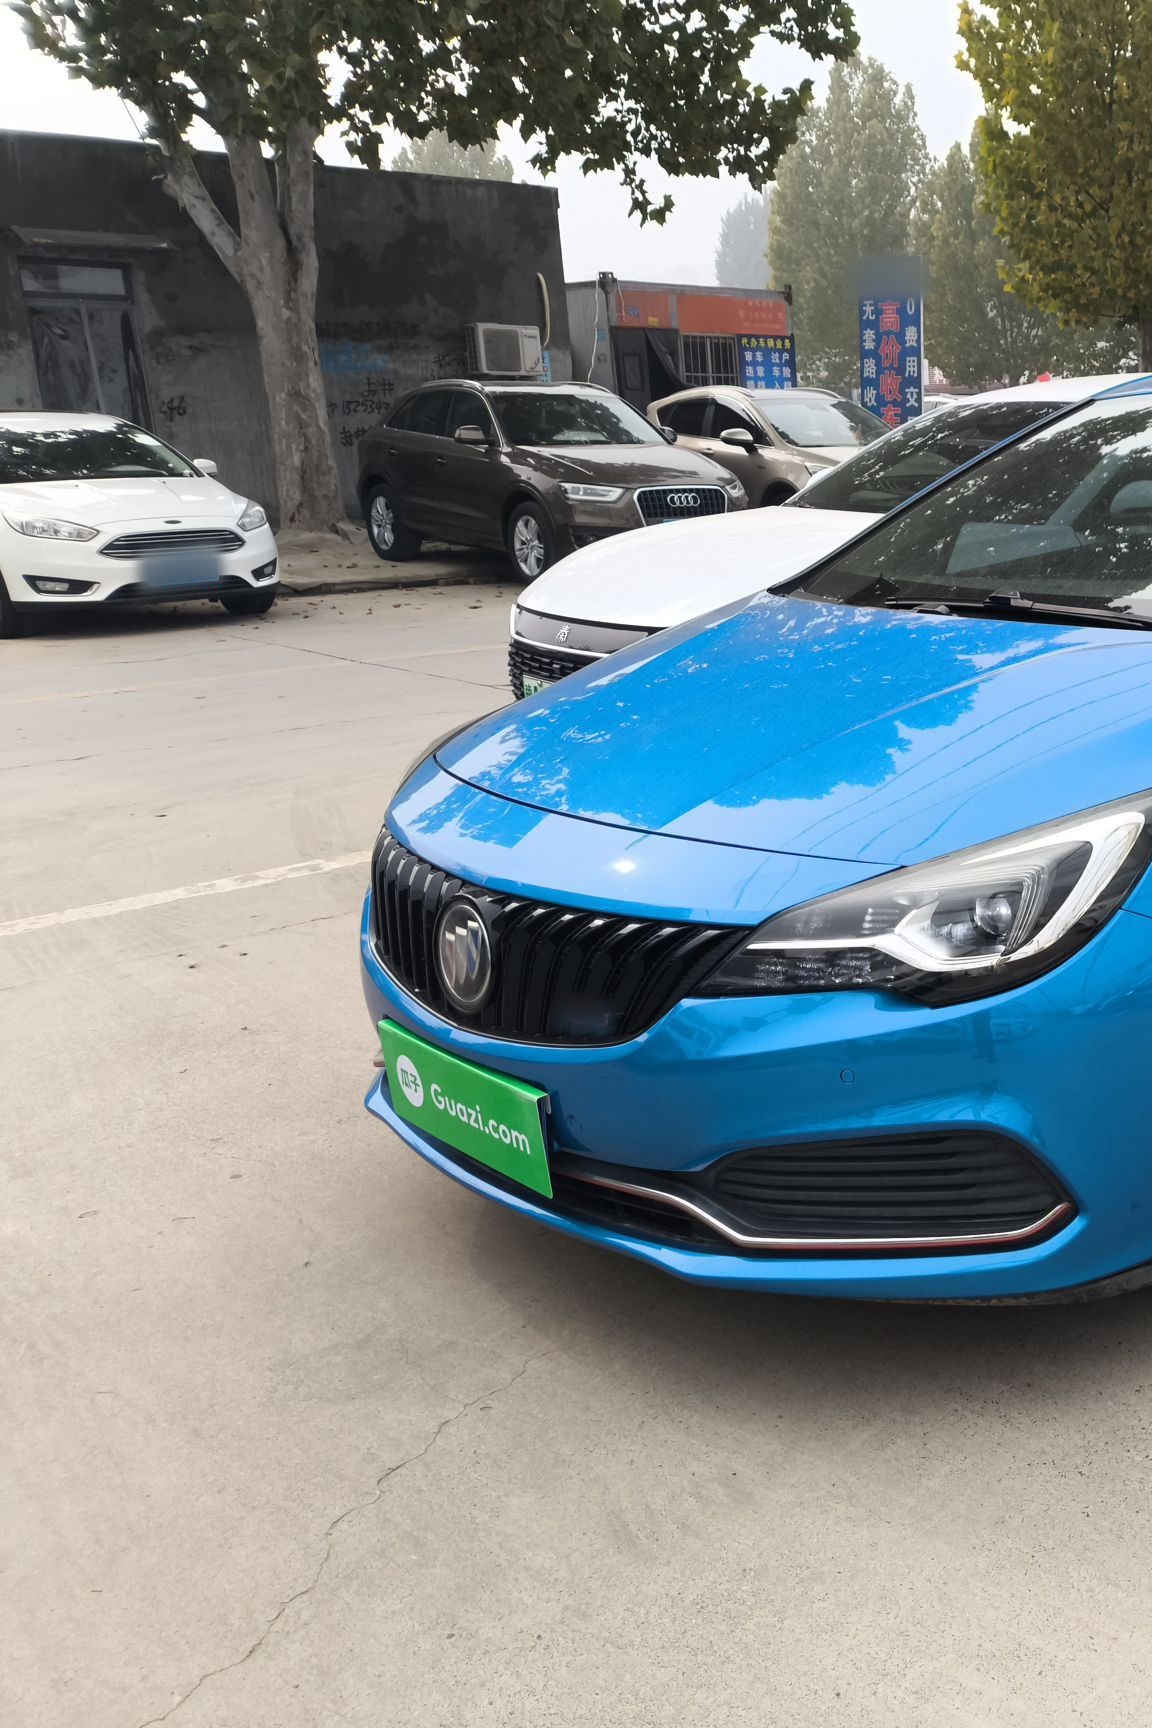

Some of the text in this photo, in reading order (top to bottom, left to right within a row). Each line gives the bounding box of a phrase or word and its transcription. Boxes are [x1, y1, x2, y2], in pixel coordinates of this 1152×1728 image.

[741, 336, 792, 350] 代办车辆业务
[862, 300, 877, 407] 无套路收
[878, 299, 903, 429] 高价收车
[904, 298, 919, 422] 0费用交
[400, 1068, 420, 1094] 瓜子
[430, 1083, 531, 1155] Guazi.com
